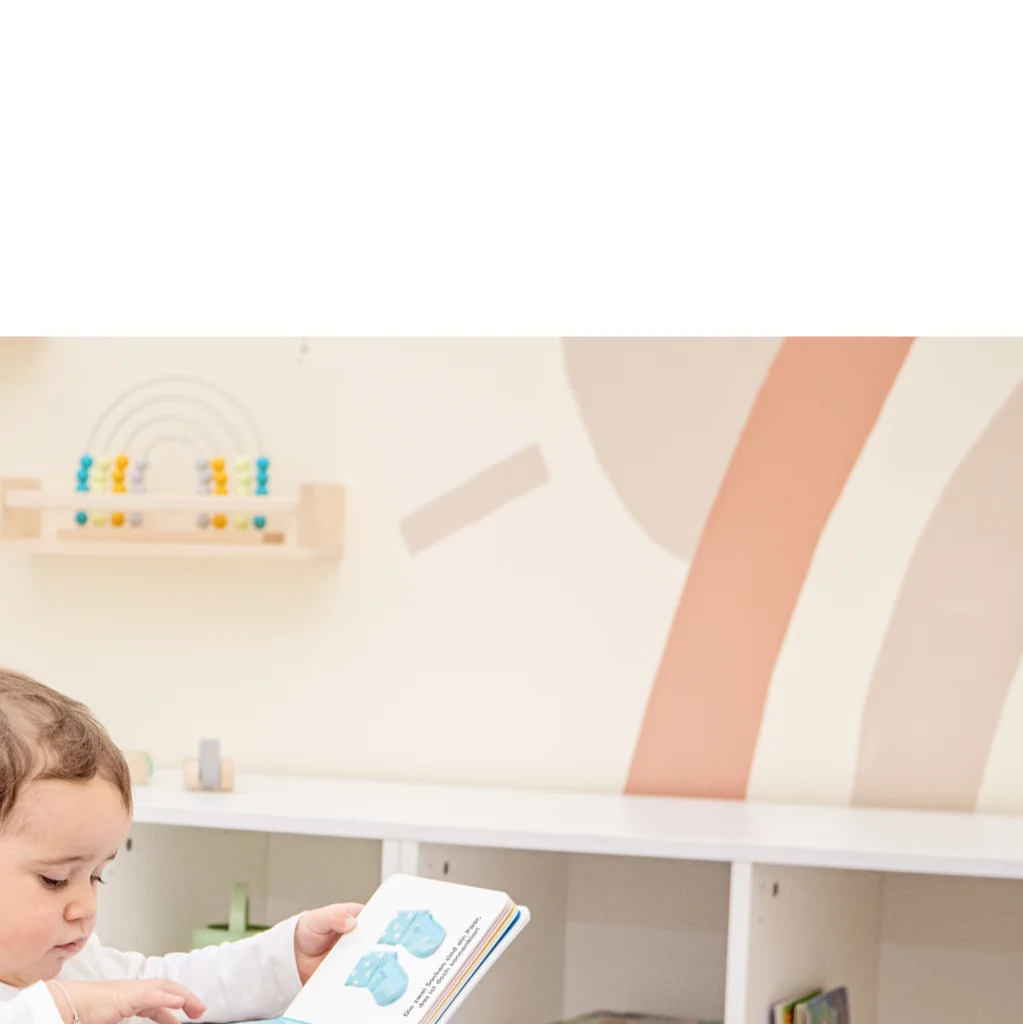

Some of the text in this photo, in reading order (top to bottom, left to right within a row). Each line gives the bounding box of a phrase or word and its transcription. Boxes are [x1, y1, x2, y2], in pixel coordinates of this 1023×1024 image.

[414, 987, 427, 1004] zwei
[425, 962, 446, 986] Socken
[445, 946, 458, 962] sind
[457, 935, 467, 946] ein
[419, 995, 430, 1008] das
[427, 985, 437, 995] ist
[436, 967, 451, 984] doch
